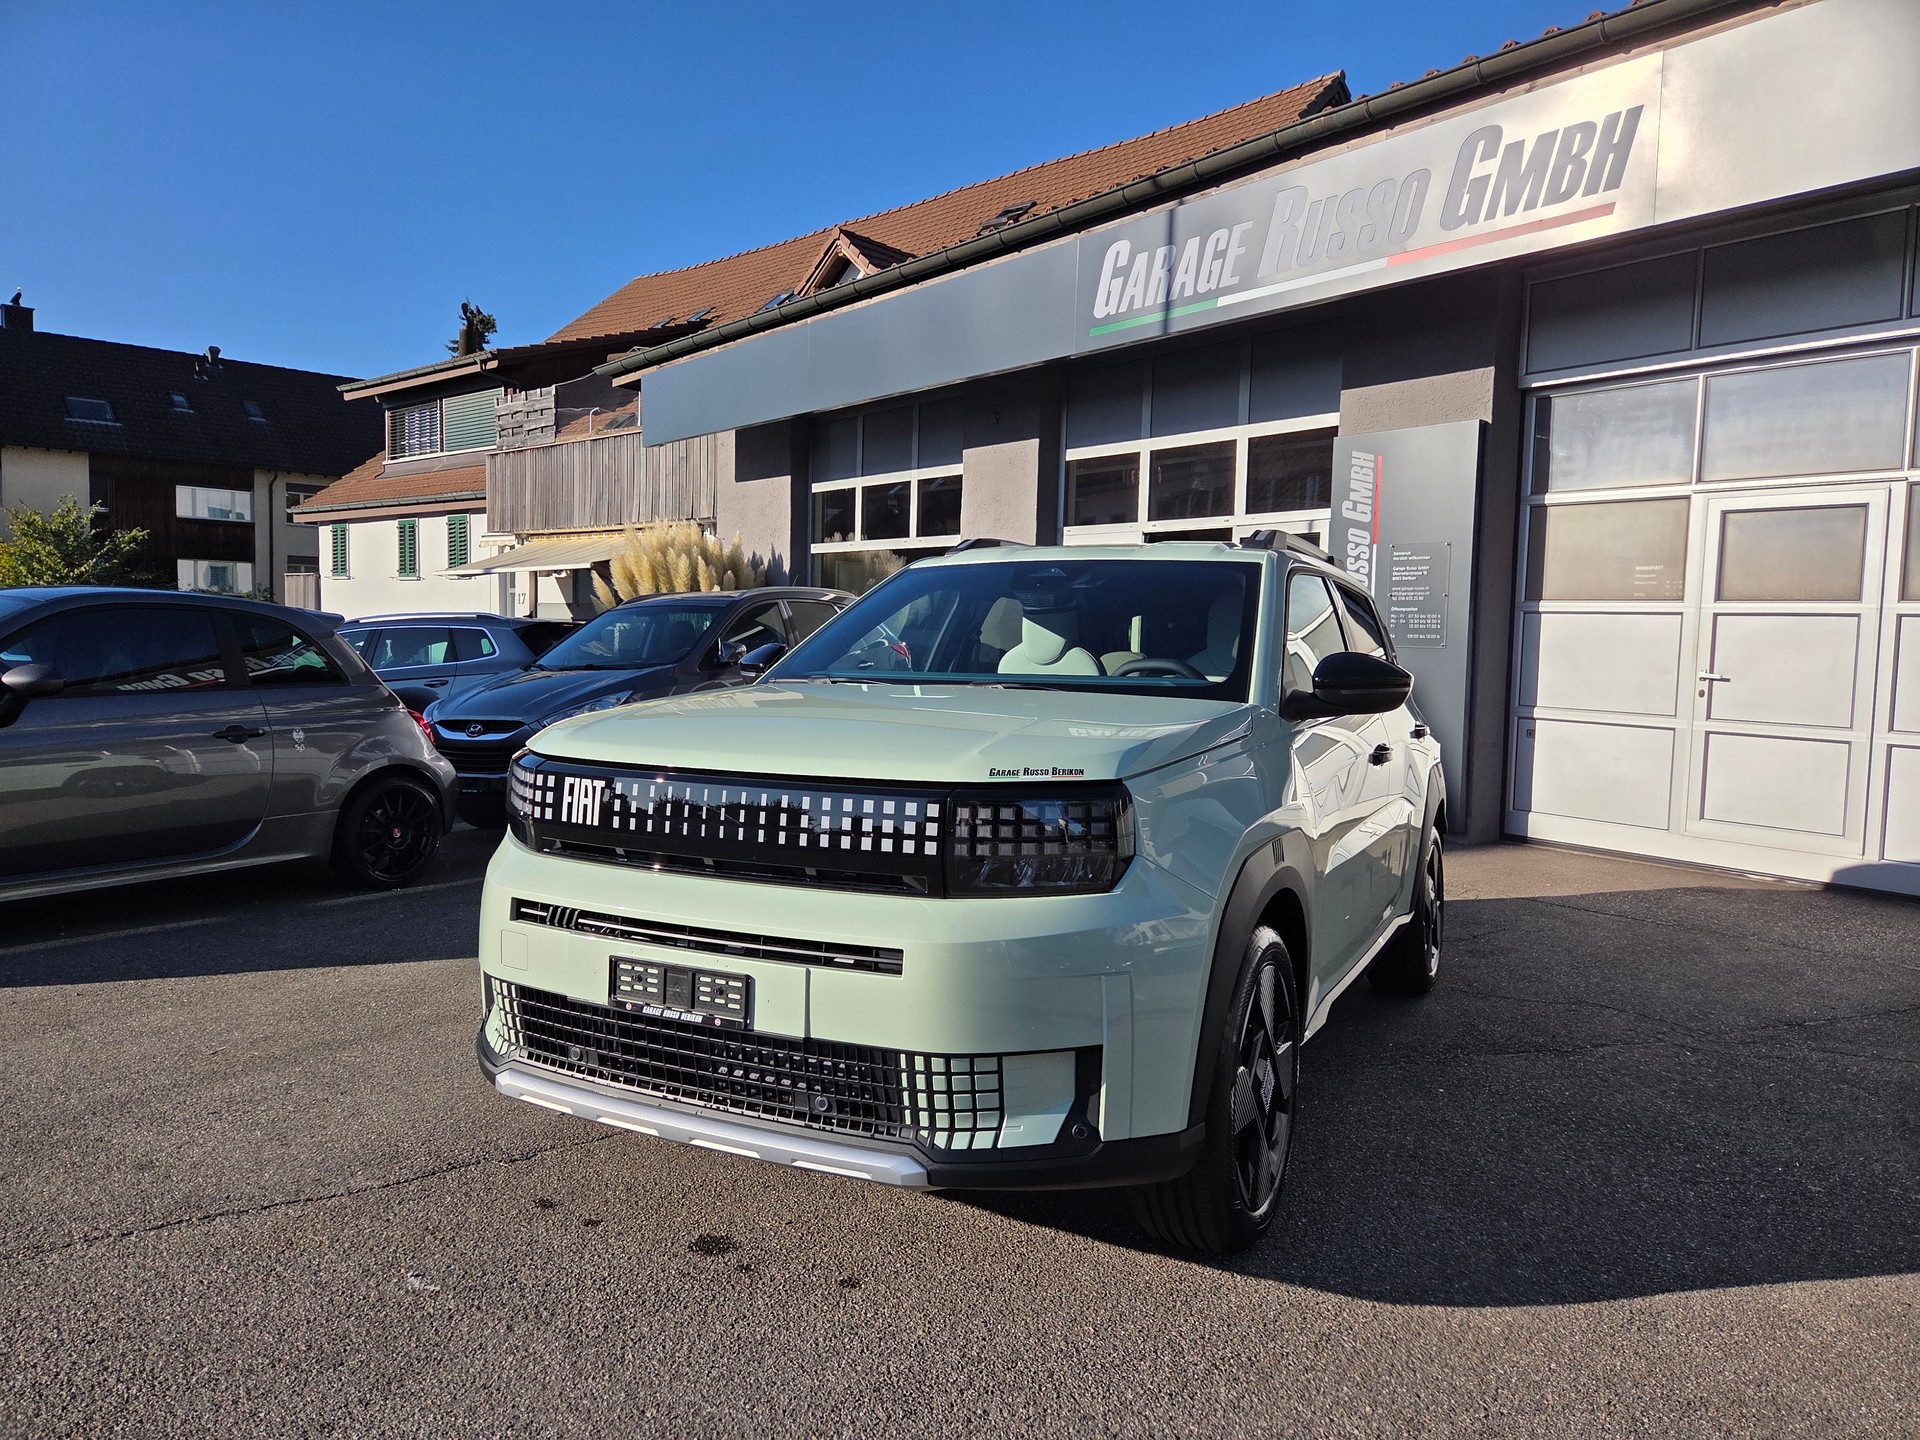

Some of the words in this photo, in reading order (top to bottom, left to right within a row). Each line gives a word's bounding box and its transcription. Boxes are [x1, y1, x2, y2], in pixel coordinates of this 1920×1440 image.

[1093, 220, 1253, 318] GARAGE
[1257, 168, 1432, 279] RUSSO
[1439, 104, 1645, 231] GMBH
[1342, 450, 1375, 523] GMBH
[517, 592, 527, 605] 17
[988, 767, 1021, 777] GARAGE
[1022, 767, 1050, 777] RUSSO
[1051, 766, 1085, 776] BERIKON
[561, 776, 606, 826] FIAT
[642, 1005, 663, 1017] GARAGE
[662, 1009, 681, 1020] RUSSO
